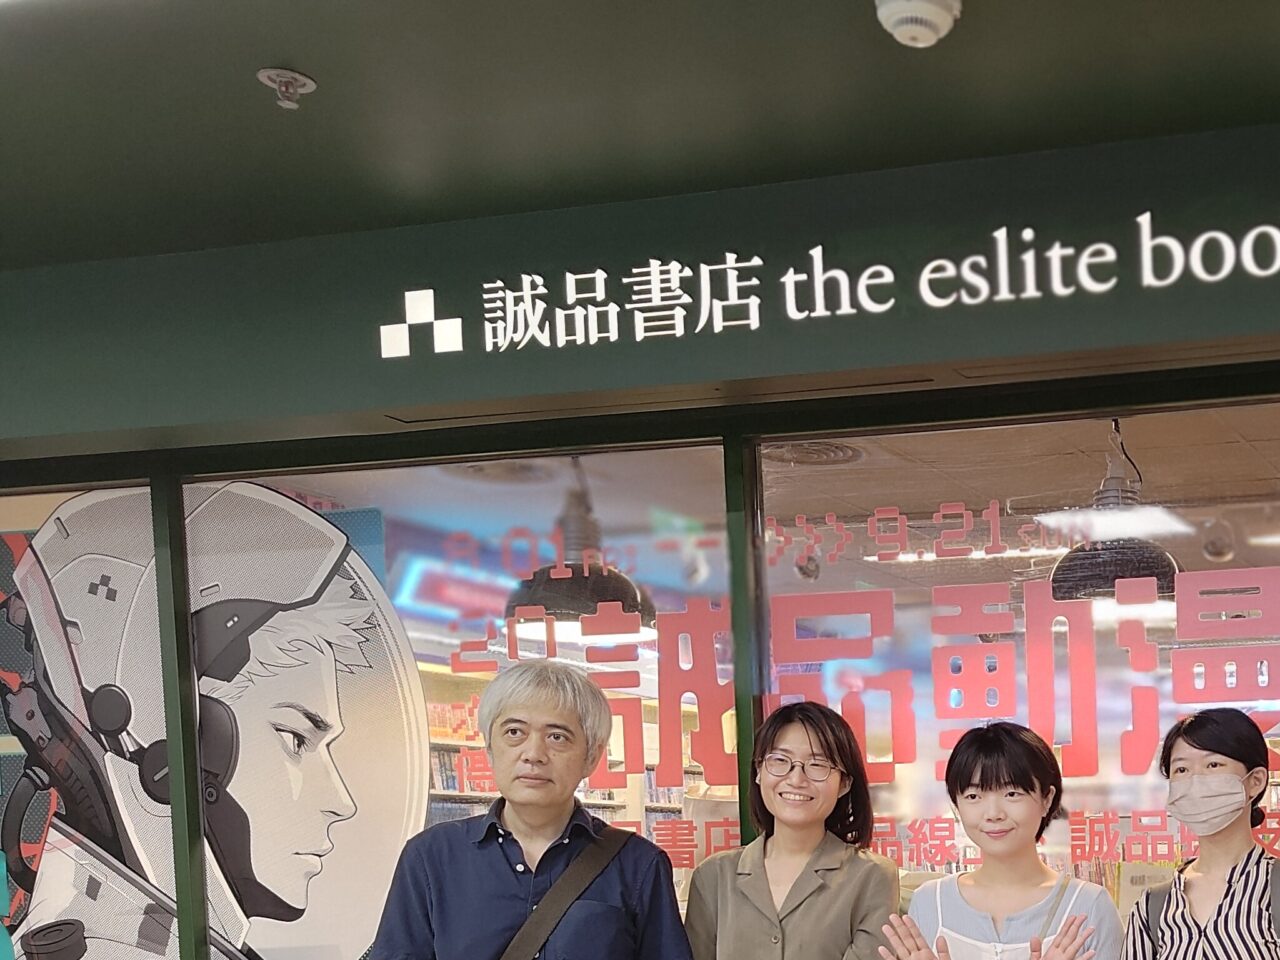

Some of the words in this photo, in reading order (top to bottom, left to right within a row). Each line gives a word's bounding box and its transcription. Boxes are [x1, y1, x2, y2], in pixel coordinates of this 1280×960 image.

[482, 252, 764, 353] 誠品書店
[782, 245, 896, 320] the
[918, 226, 1118, 307] eslite
[867, 500, 1008, 561] 9.21
